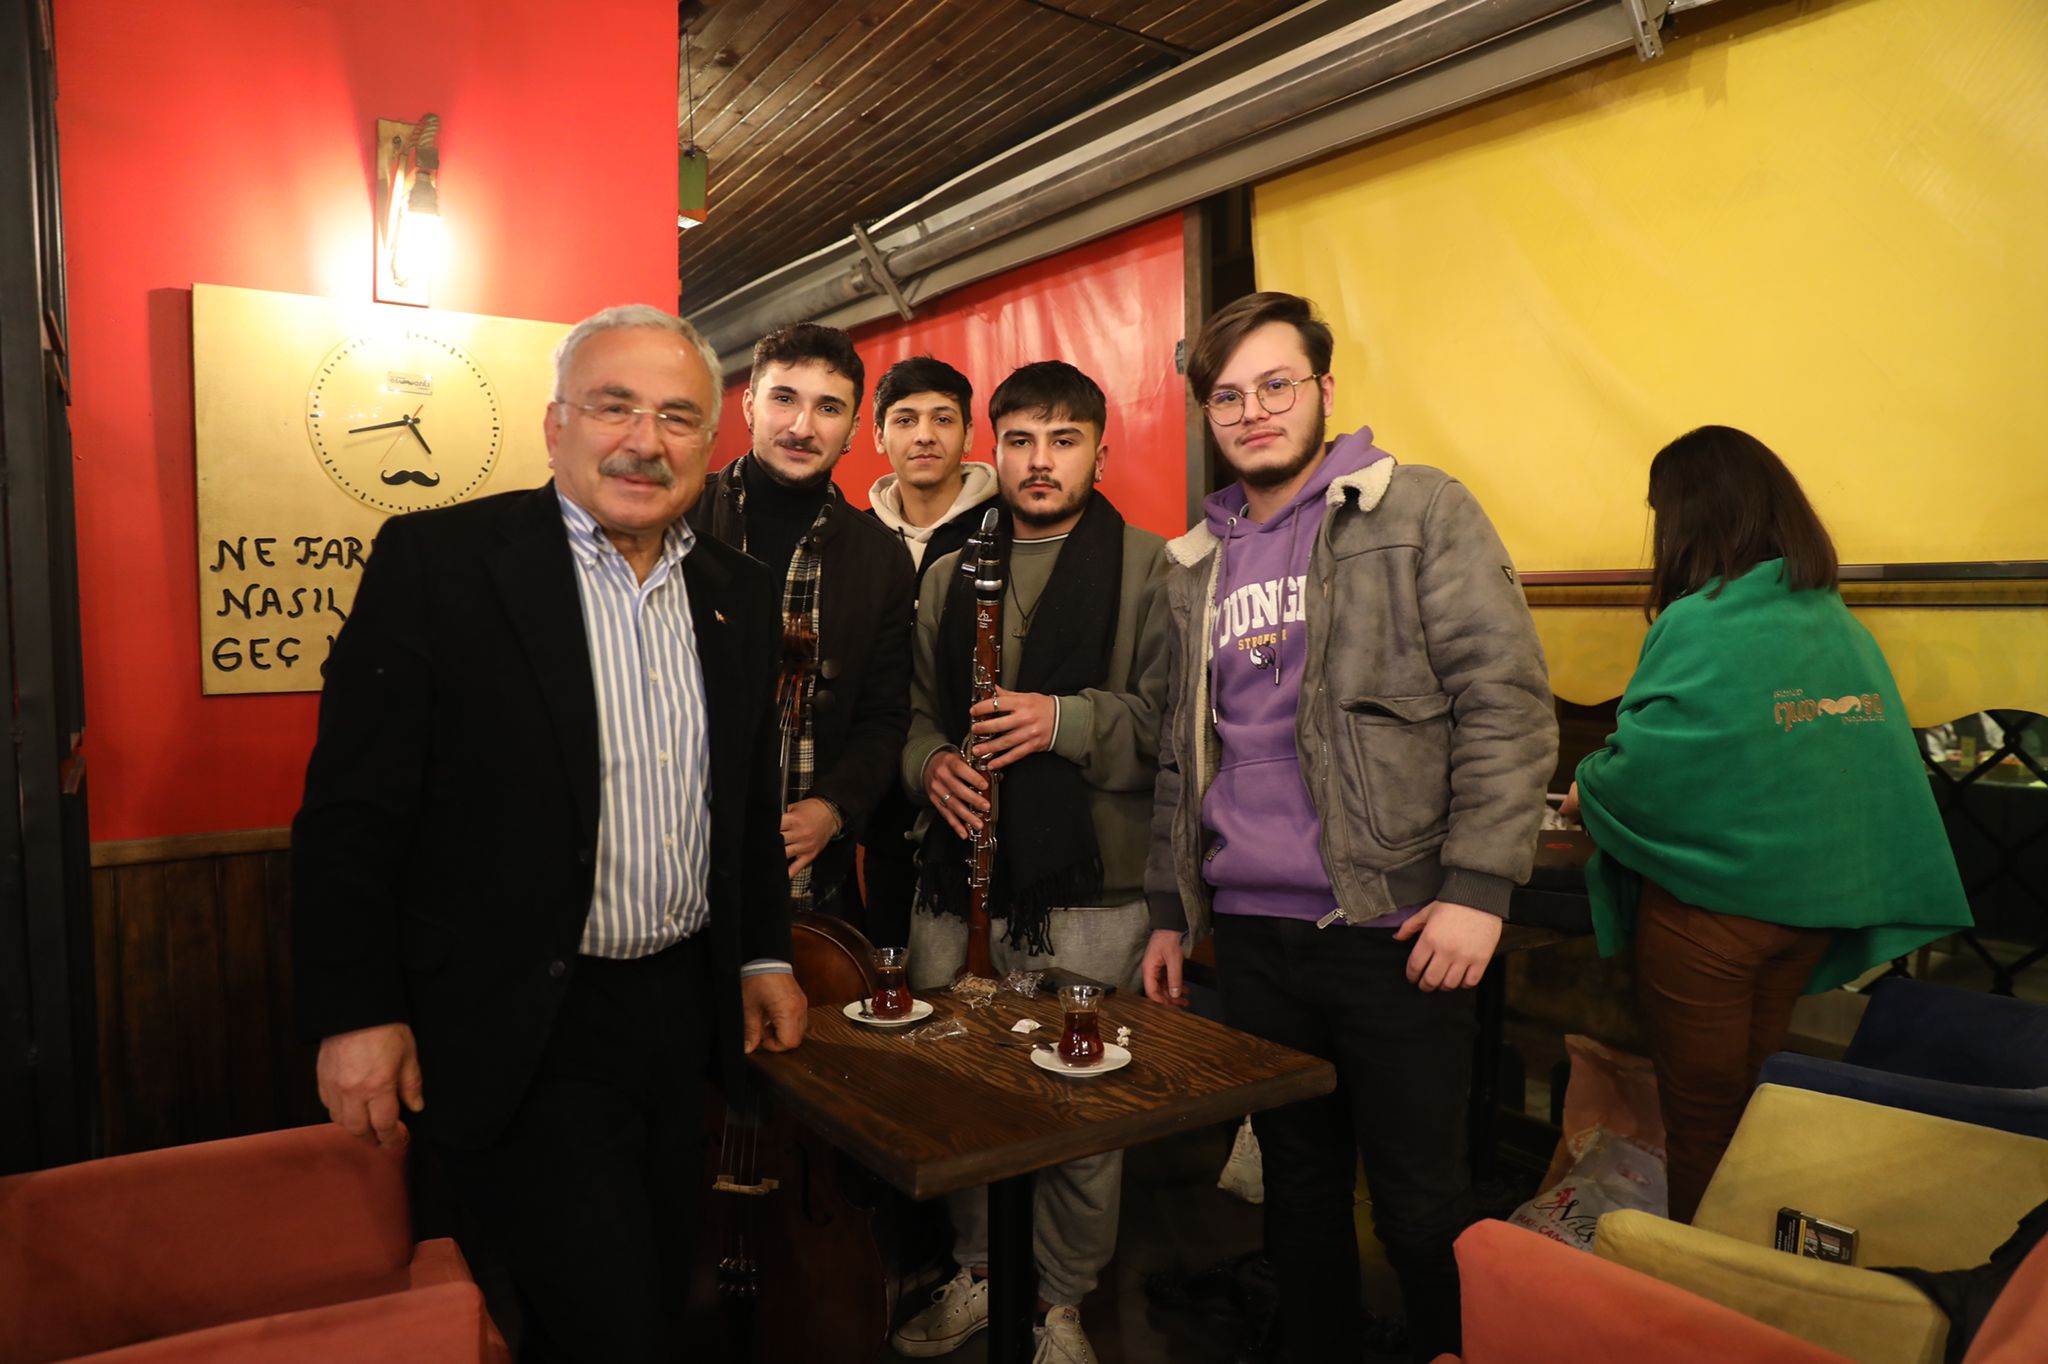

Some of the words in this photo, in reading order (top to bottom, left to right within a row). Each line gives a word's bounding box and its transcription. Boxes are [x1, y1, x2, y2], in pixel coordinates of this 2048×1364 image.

[210, 536, 276, 573] NE
[294, 536, 375, 570] FAR
[217, 583, 347, 622] NASIL
[211, 636, 302, 672] GEÇ
